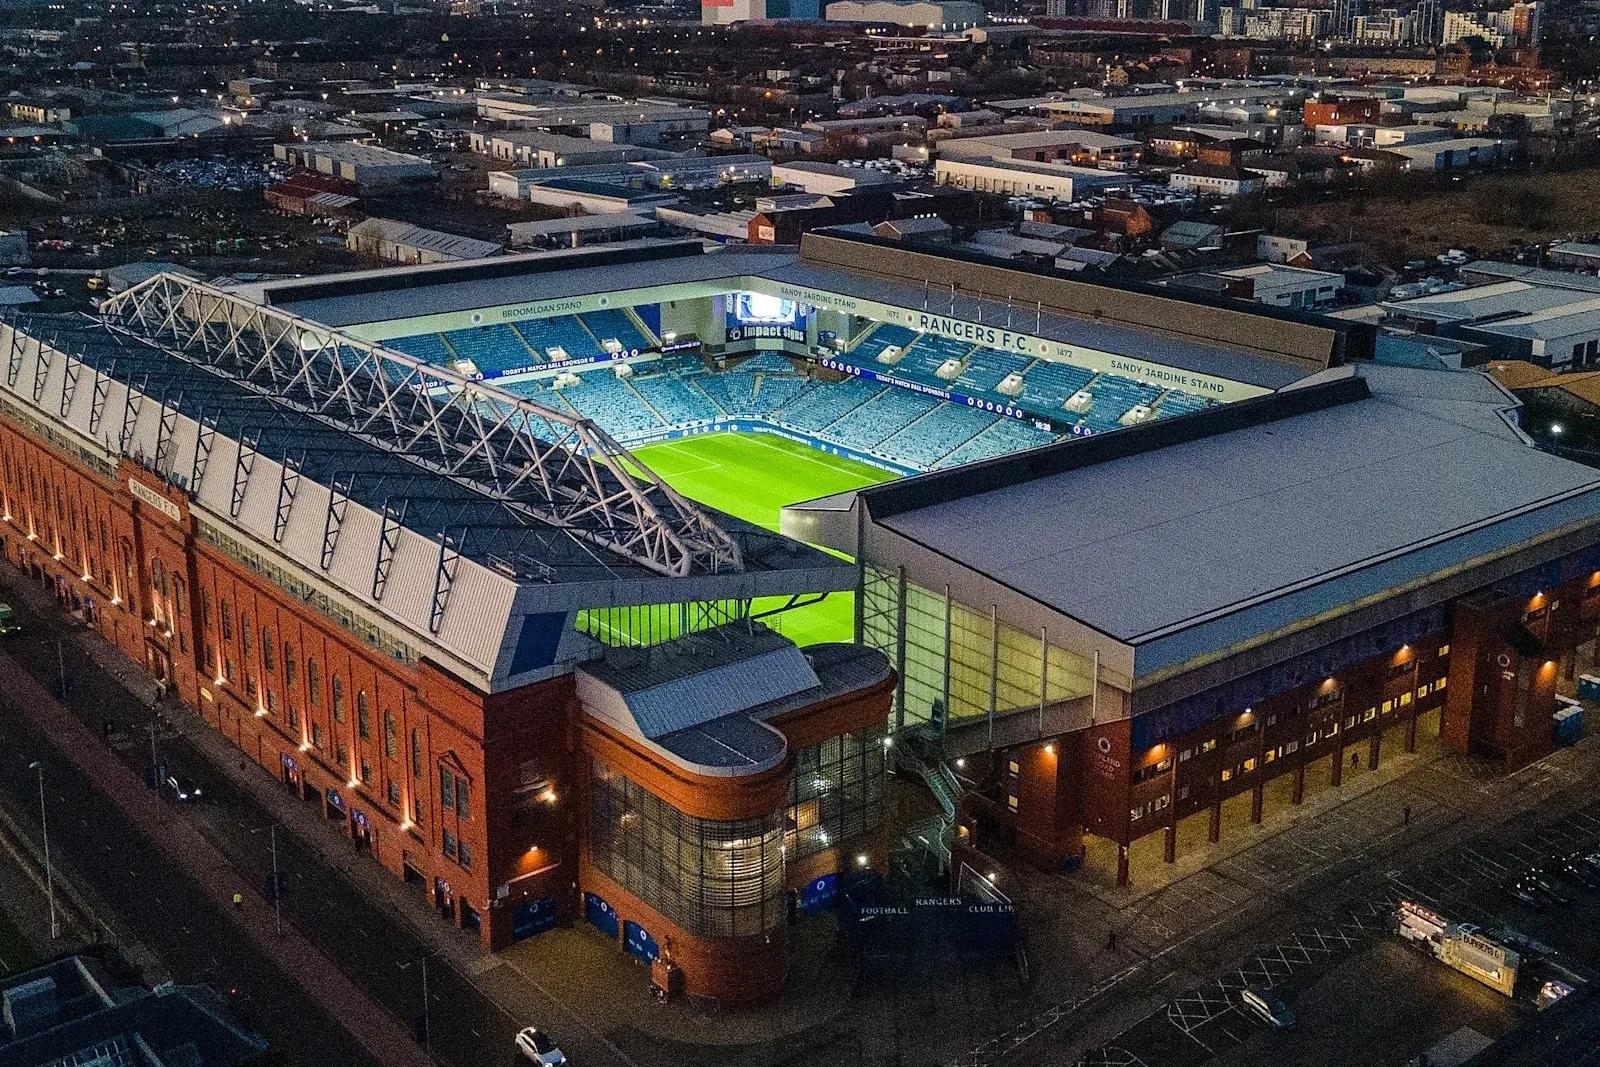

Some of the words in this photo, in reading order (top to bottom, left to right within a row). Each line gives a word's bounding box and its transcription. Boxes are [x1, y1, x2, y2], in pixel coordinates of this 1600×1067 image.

[781, 286, 802, 297] SANDY
[803, 291, 832, 304] JARDINE
[834, 298, 857, 309] STAND
[502, 305, 555, 318] BROOMLOAN
[556, 301, 582, 312] STAND
[920, 315, 996, 343] RANGERS
[1002, 333, 1032, 352] F.C.
[527, 364, 547, 373] MATCH
[548, 361, 561, 369] BALL
[562, 358, 588, 367] SPONSOR
[1110, 360, 1143, 374] SANDY
[1145, 368, 1188, 385] JARDINE
[1190, 378, 1225, 393] STAND
[915, 898, 962, 906] RANGERS
[968, 905, 994, 913] CLUB
